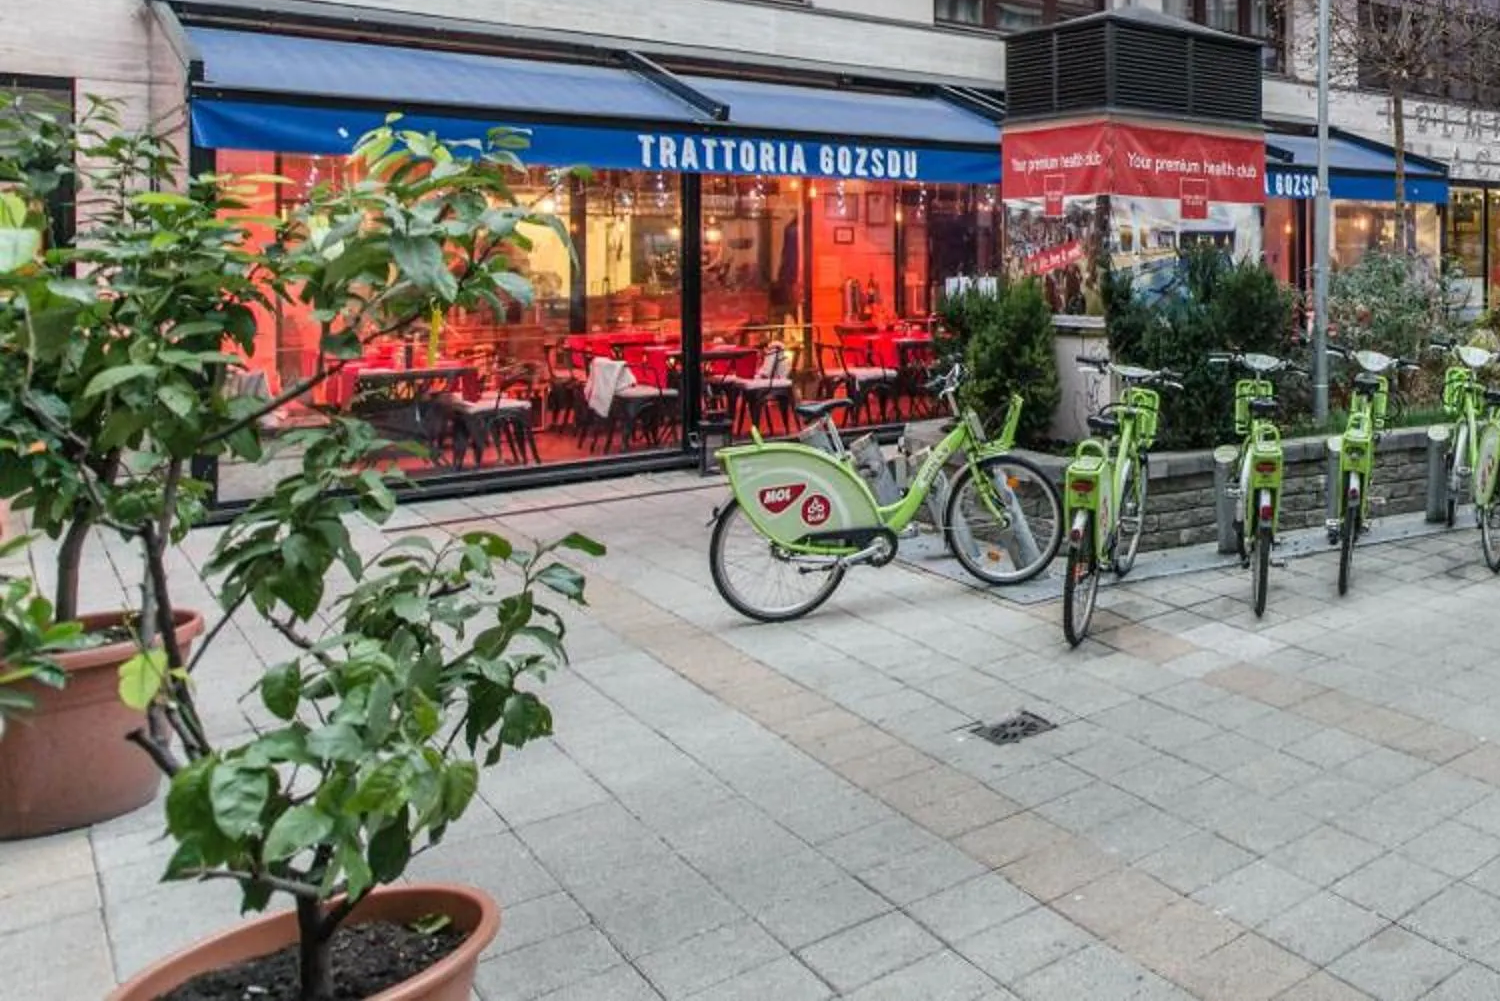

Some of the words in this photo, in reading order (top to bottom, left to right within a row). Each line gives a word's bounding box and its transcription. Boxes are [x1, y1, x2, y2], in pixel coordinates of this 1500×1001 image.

[637, 134, 807, 174] TRATTORIA
[819, 145, 918, 179] GOZSDU
[1127, 151, 1152, 170] Your
[1155, 159, 1200, 175] premium
[1275, 172, 1331, 199] GOZSD
